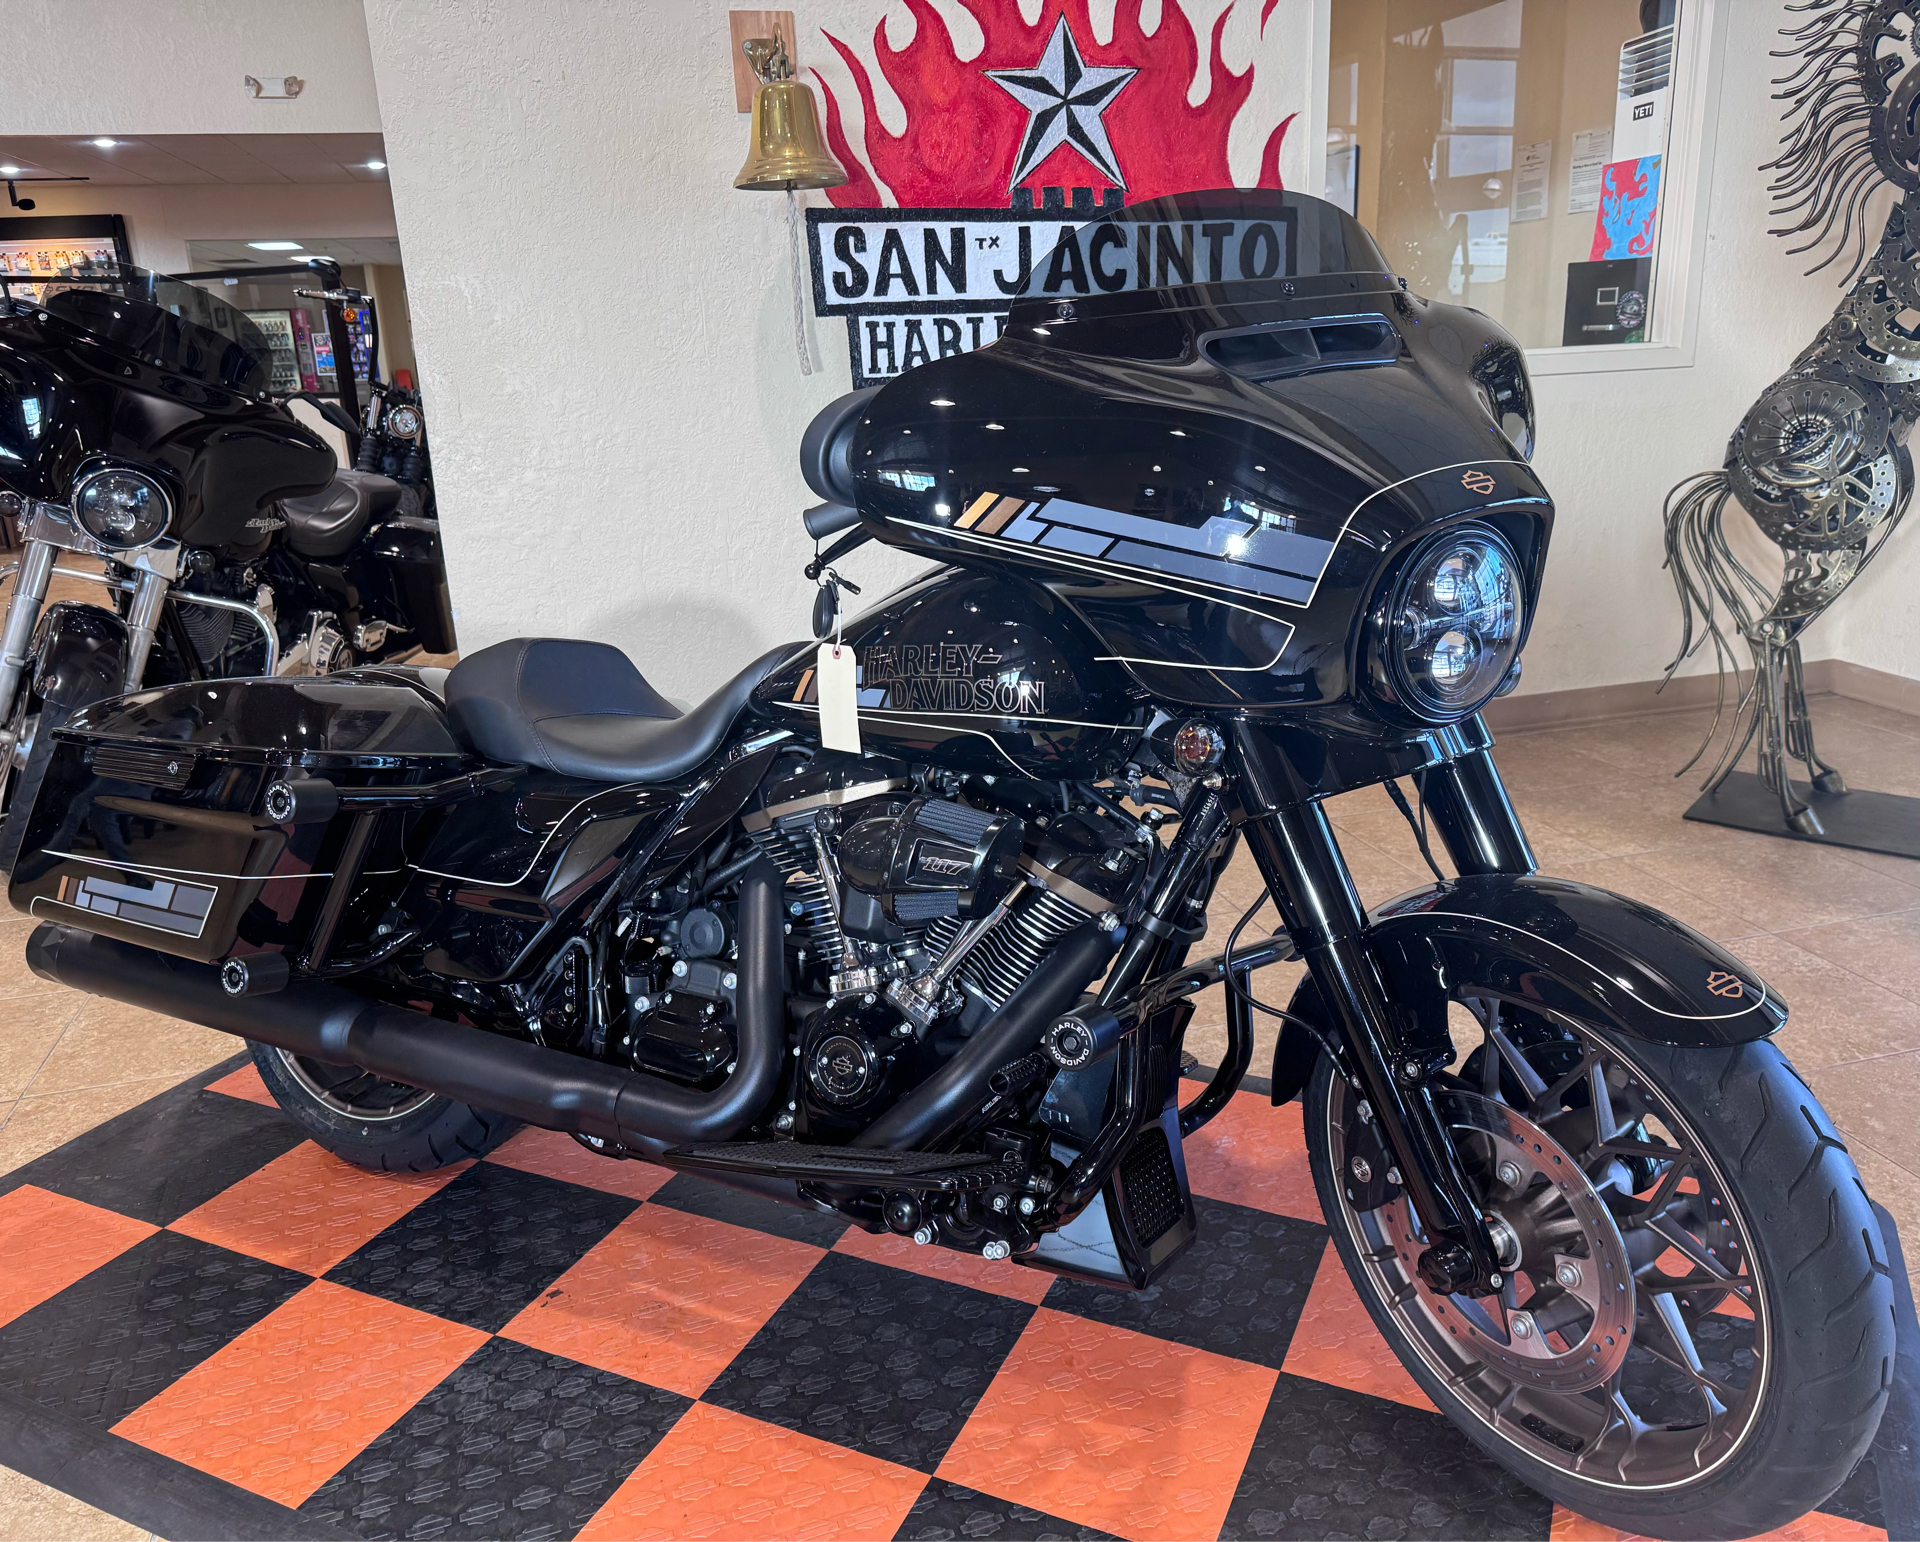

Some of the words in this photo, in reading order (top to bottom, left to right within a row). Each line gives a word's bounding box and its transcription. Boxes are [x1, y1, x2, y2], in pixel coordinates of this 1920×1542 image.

[1634, 105, 1653, 118] YETI
[832, 224, 968, 298] SAN
[974, 235, 1000, 250] TX
[993, 221, 1282, 295] JACINTO
[889, 678, 1046, 715] DAVIDSON
[920, 856, 973, 876] 117
[1051, 1022, 1088, 1037] HARLEY
[1050, 1046, 1090, 1066] DAVIDSON
